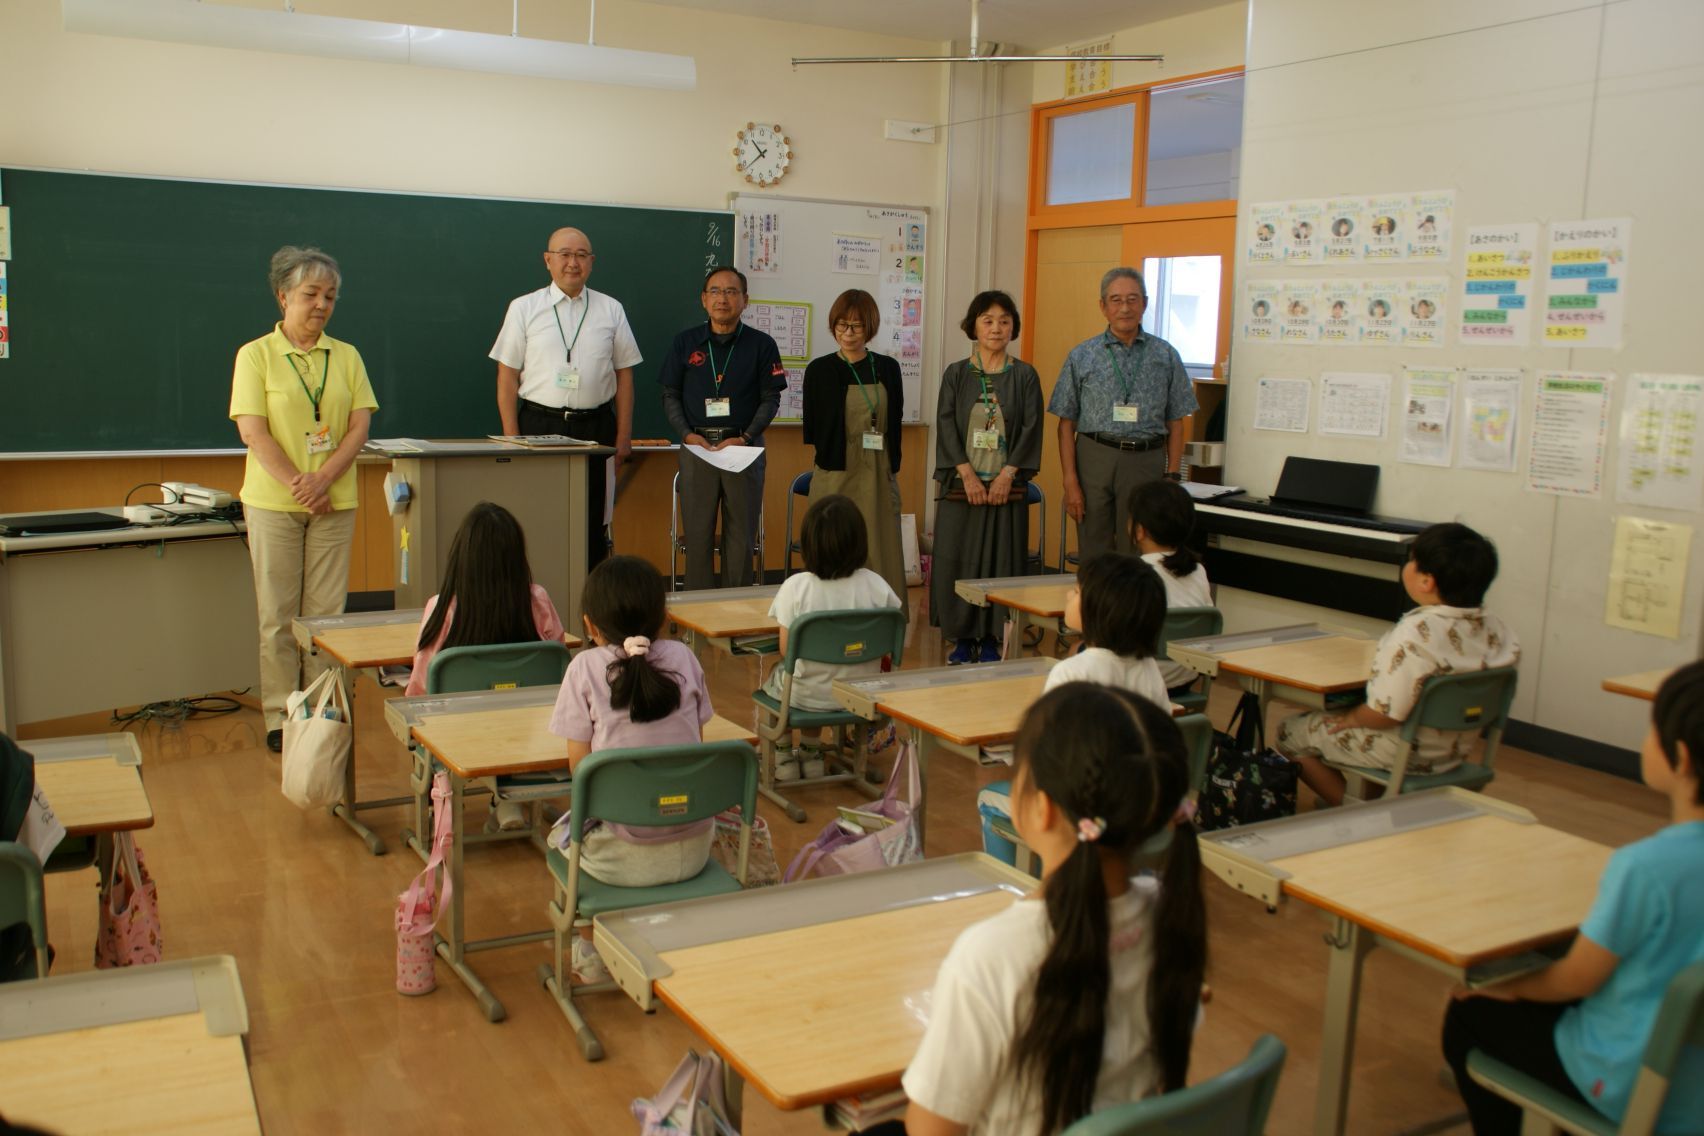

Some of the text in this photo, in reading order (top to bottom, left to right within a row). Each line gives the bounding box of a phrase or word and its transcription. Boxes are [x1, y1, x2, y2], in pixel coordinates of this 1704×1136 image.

[706, 222, 721, 246] 9/16
[898, 227, 902, 236] 1
[896, 258, 902, 268] 2
[894, 300, 901, 309] 3
[893, 332, 900, 341] 4
